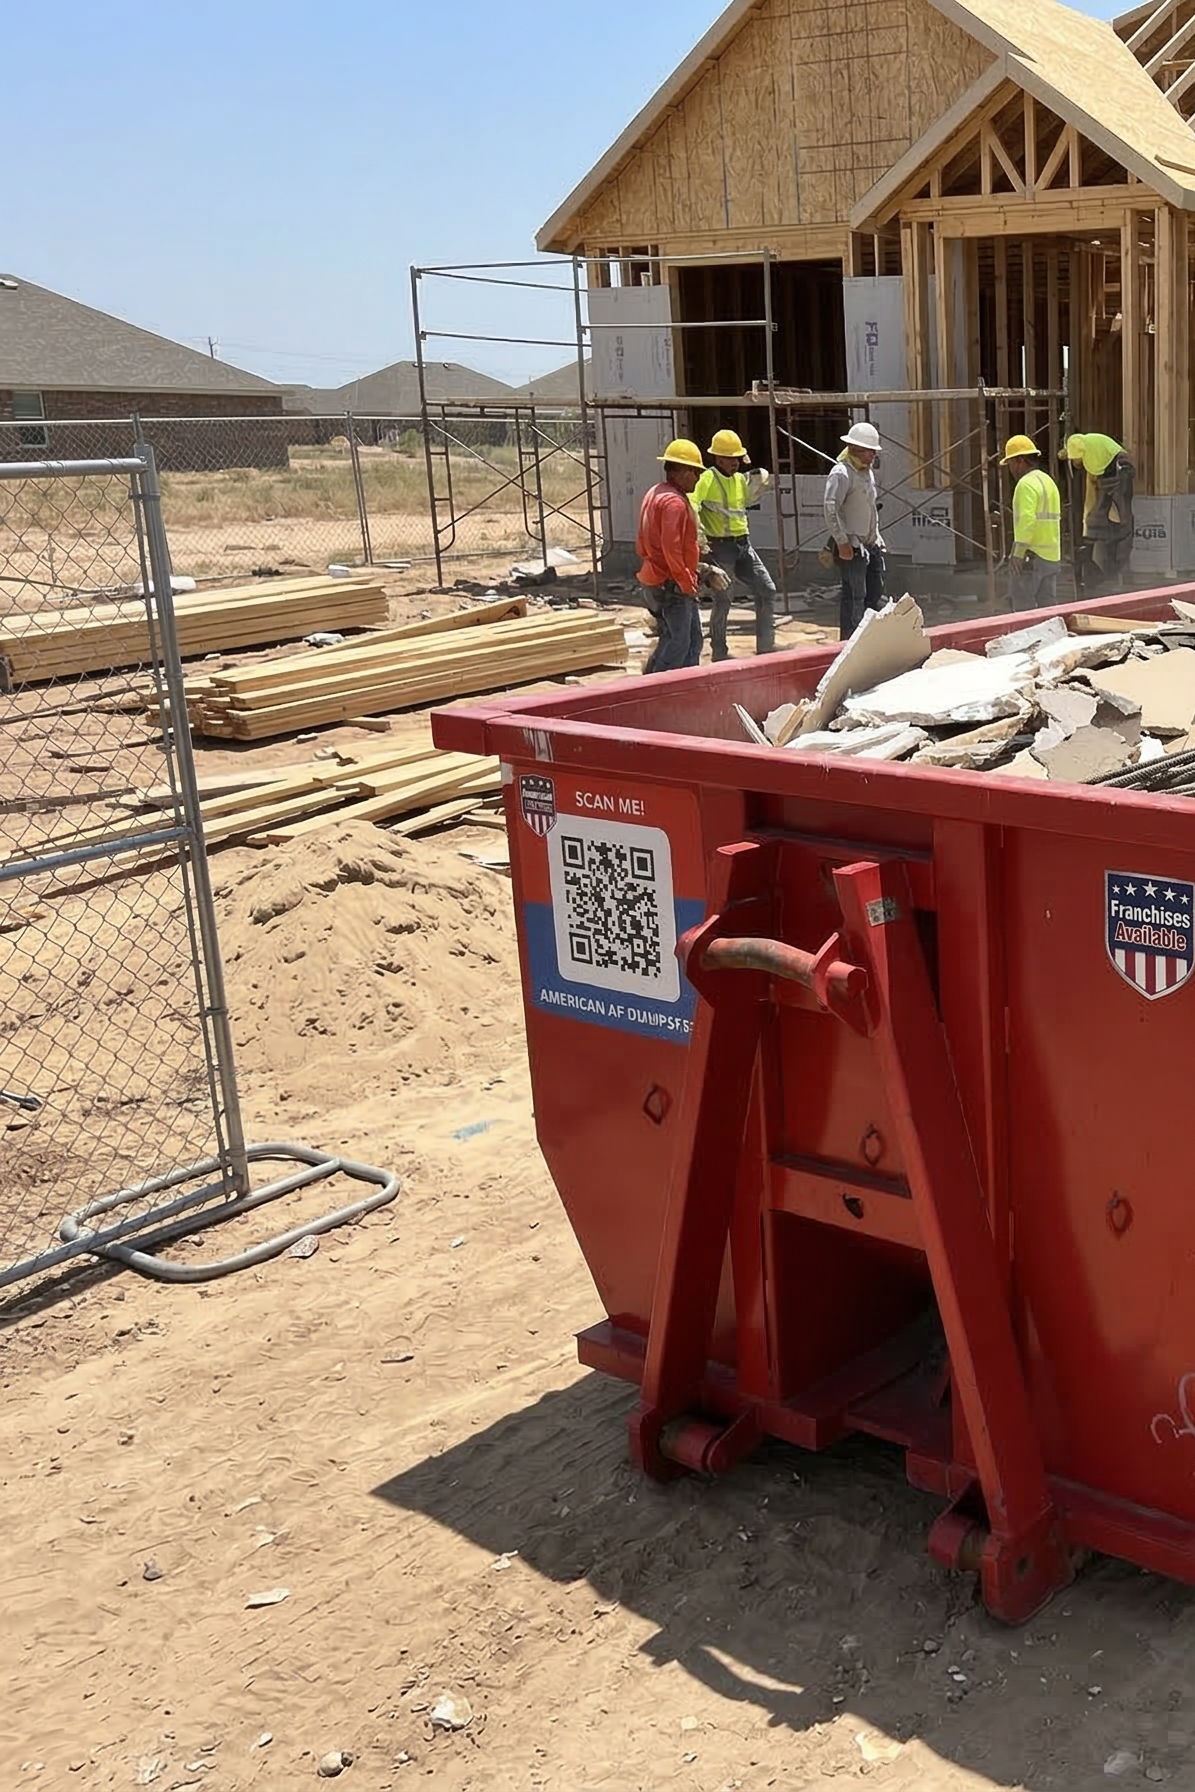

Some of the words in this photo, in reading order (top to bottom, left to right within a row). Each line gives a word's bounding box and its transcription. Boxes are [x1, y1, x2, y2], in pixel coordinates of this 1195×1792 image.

[575, 791, 615, 813] SCAN
[618, 797, 645, 816] ME!
[1111, 899, 1191, 929] Franchises
[1115, 920, 1187, 952] Available
[540, 988, 606, 1016] AMERICAN
[608, 1003, 625, 1019] AF
